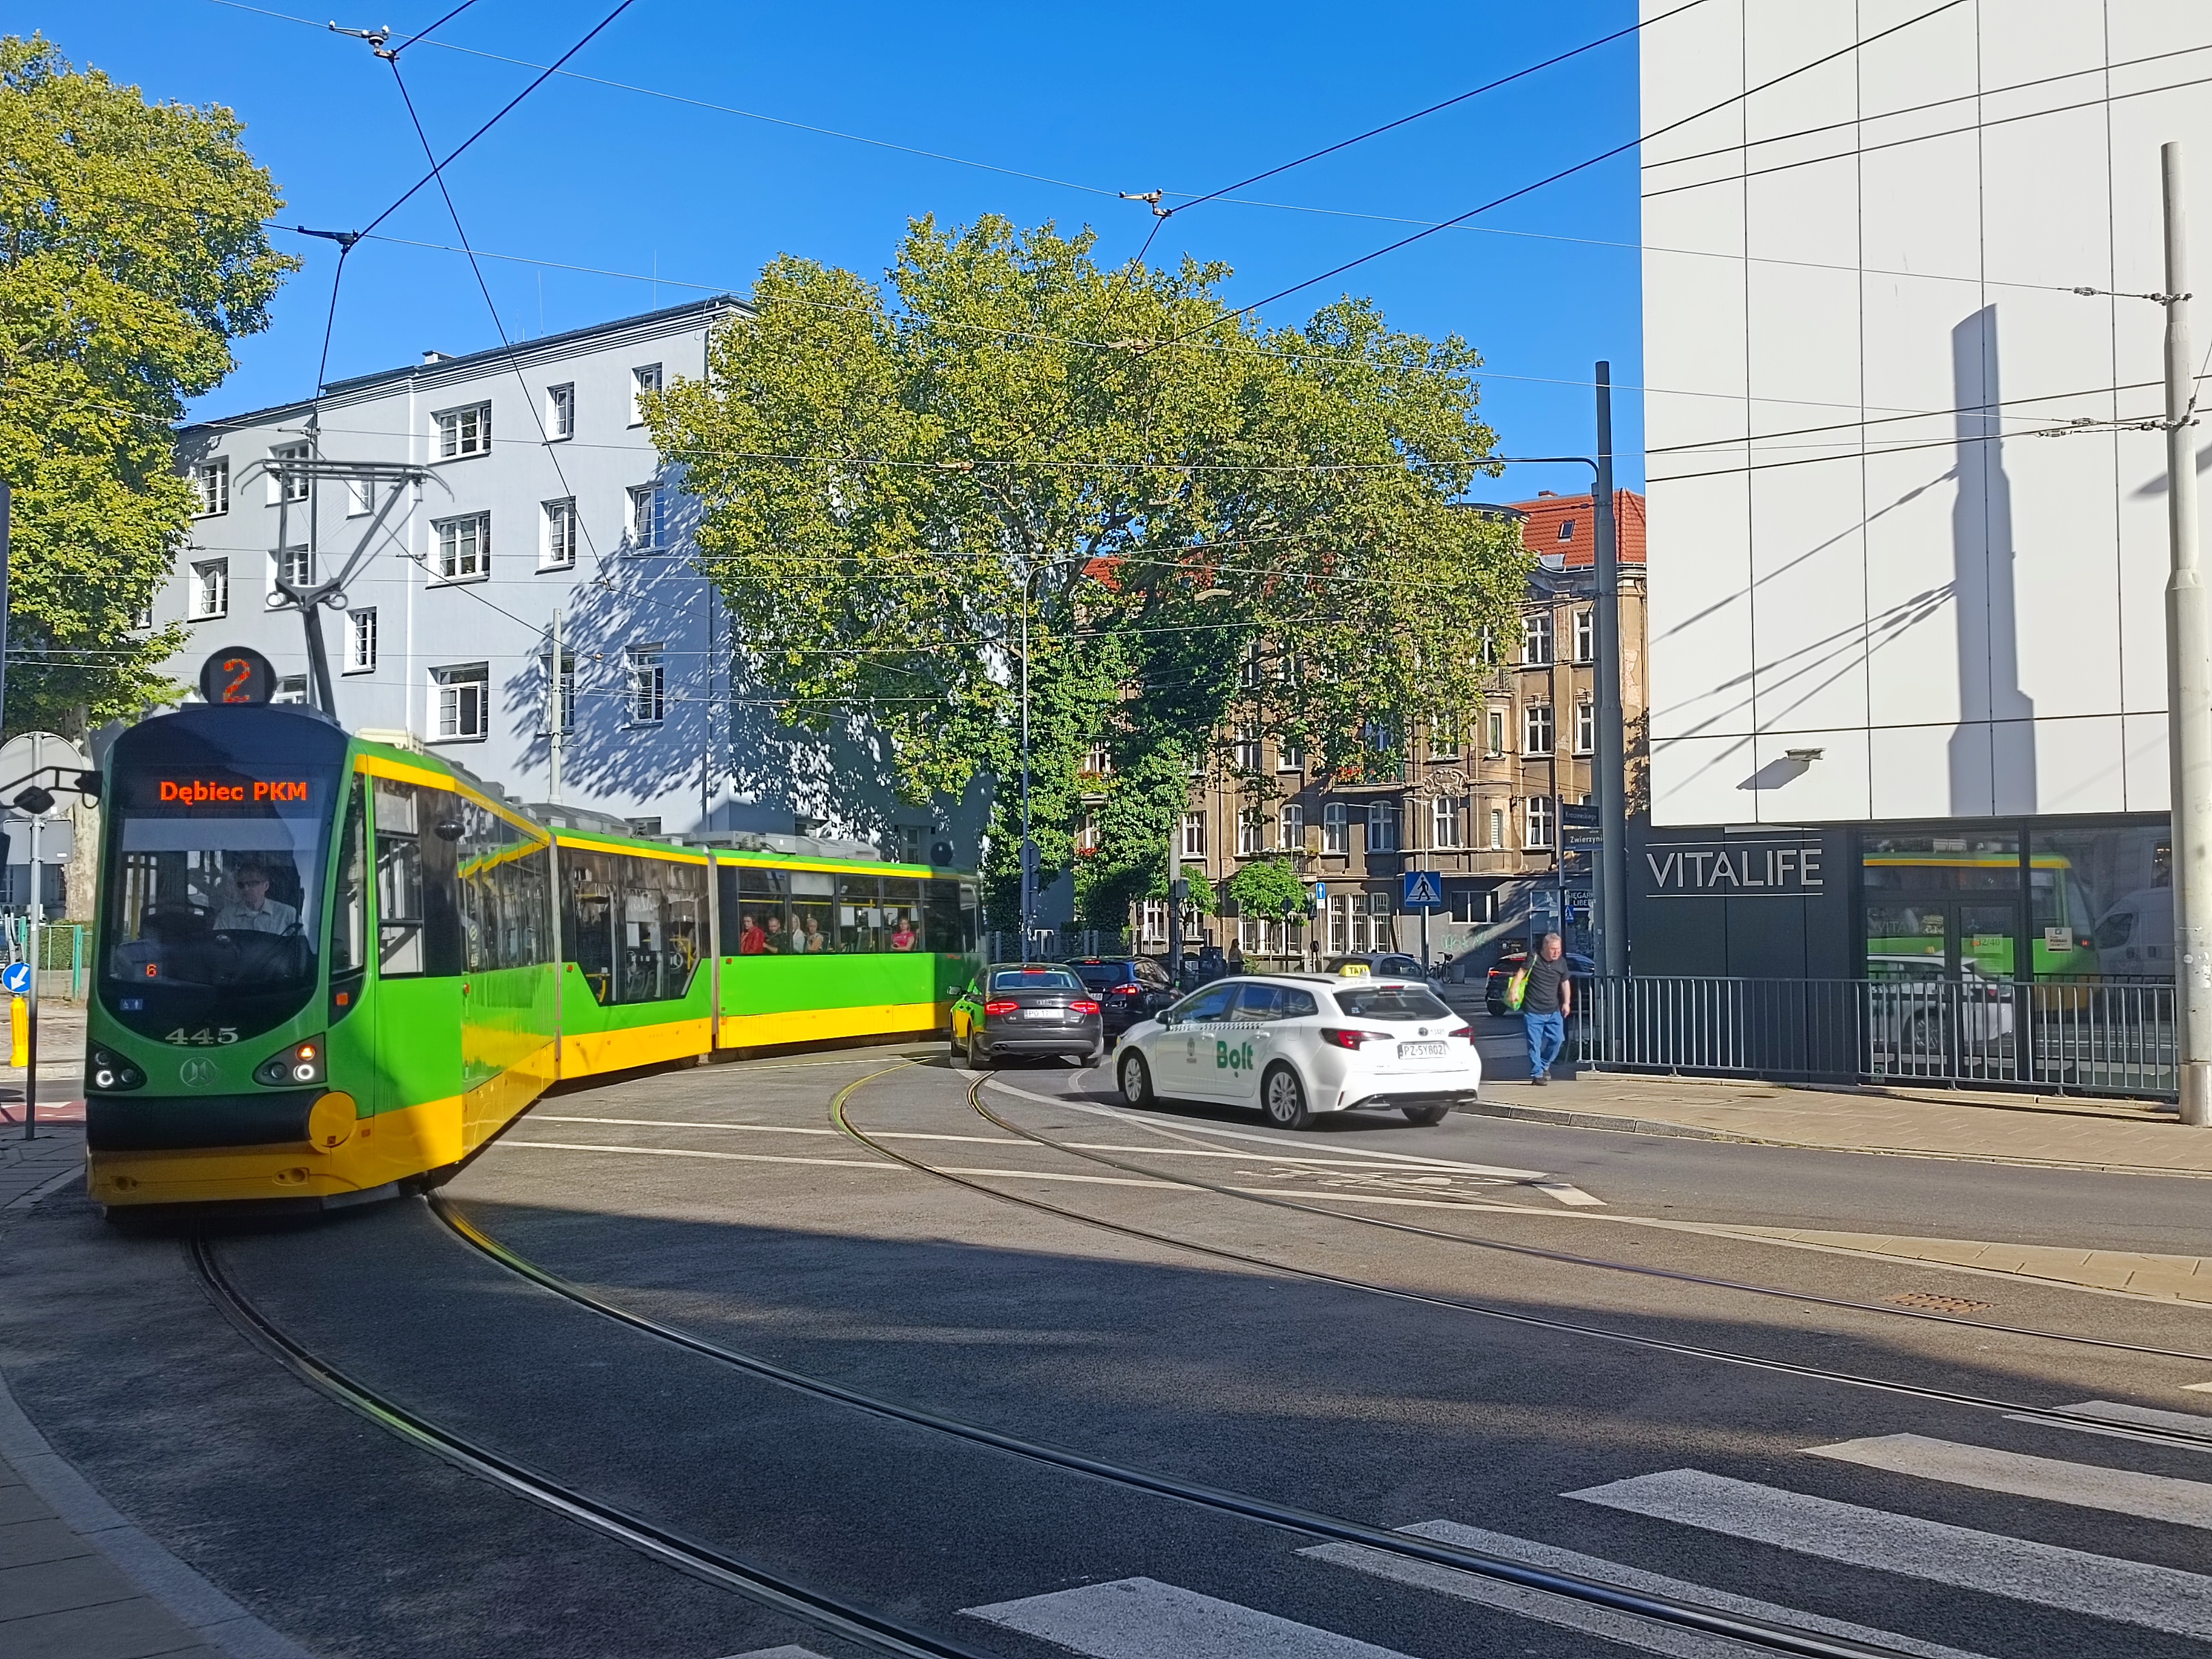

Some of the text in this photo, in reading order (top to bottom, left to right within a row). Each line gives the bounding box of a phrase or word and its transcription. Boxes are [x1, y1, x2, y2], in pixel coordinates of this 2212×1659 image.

[223, 659, 250, 703] 2
[160, 780, 307, 806] Dębiec PKM
[1570, 834, 1603, 844] Zwierzyni
[1646, 849, 1823, 887] VITALIFE
[165, 1027, 238, 1045] 445
[1217, 1041, 1254, 1070] Bolt
